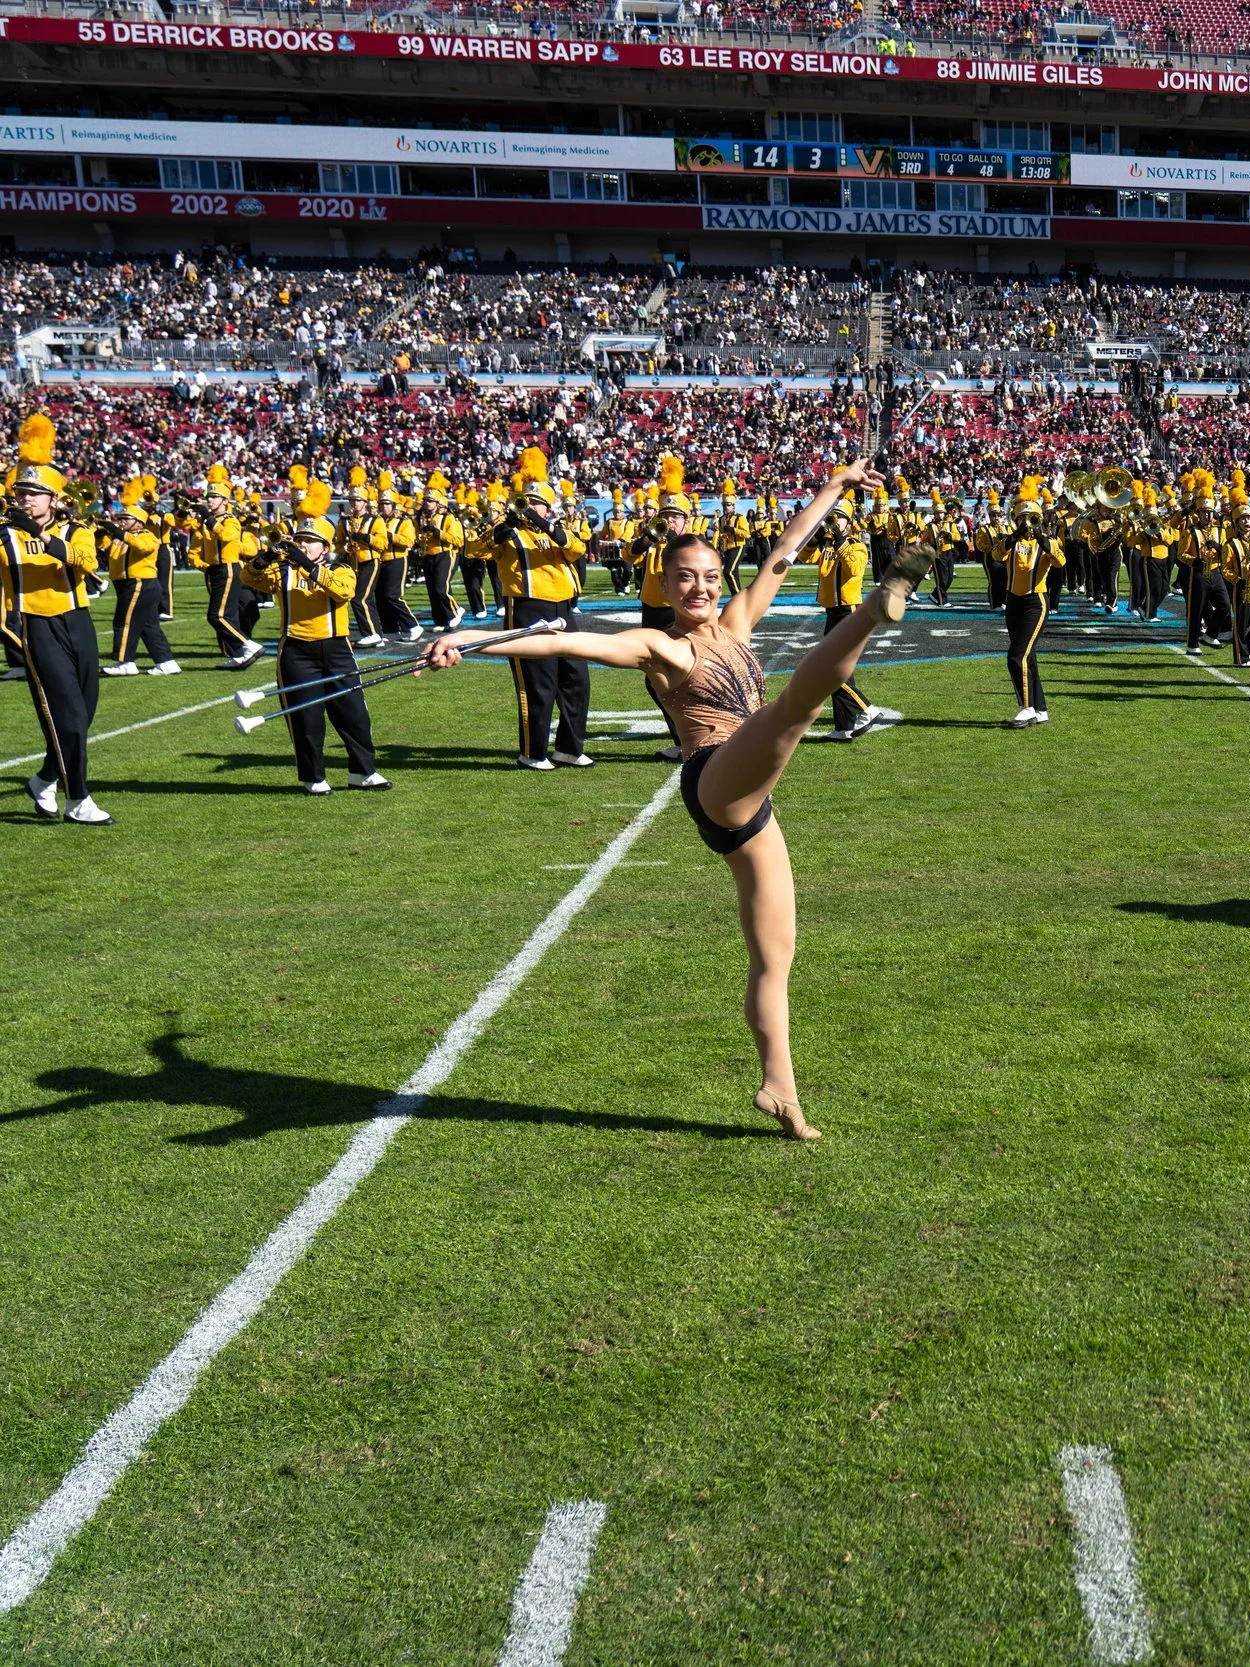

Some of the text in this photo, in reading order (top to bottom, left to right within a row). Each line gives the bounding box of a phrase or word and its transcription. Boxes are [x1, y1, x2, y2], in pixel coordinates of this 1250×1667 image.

[79, 22, 332, 51] 55 DERRICK BROOKS
[398, 36, 598, 61] 99 WARREN SAPP
[660, 48, 880, 74] 63 LEE ROY SELMON
[937, 60, 1102, 85] 88 JIMMIE GILES
[1158, 70, 1213, 90] JOHN
[0, 127, 176, 141] ARTIS Reimagining Medicine
[416, 140, 496, 154] NOVARTIS
[513, 145, 565, 155] Reimagining
[753, 147, 777, 166] 14
[810, 148, 821, 168] 3
[898, 152, 923, 160] DOWN
[939, 153, 949, 161] TO
[969, 155, 989, 163] BALL
[900, 162, 921, 173] 3RD
[947, 164, 953, 175] 4
[980, 166, 993, 176] 48
[1021, 167, 1050, 178] 13:08
[1147, 167, 1216, 180] NOVARTIS
[171, 195, 228, 214] 2002
[299, 198, 354, 217] 2020
[705, 208, 1049, 237] RAYMOND JAMES STADIUM
[1096, 347, 1142, 355] METERS
